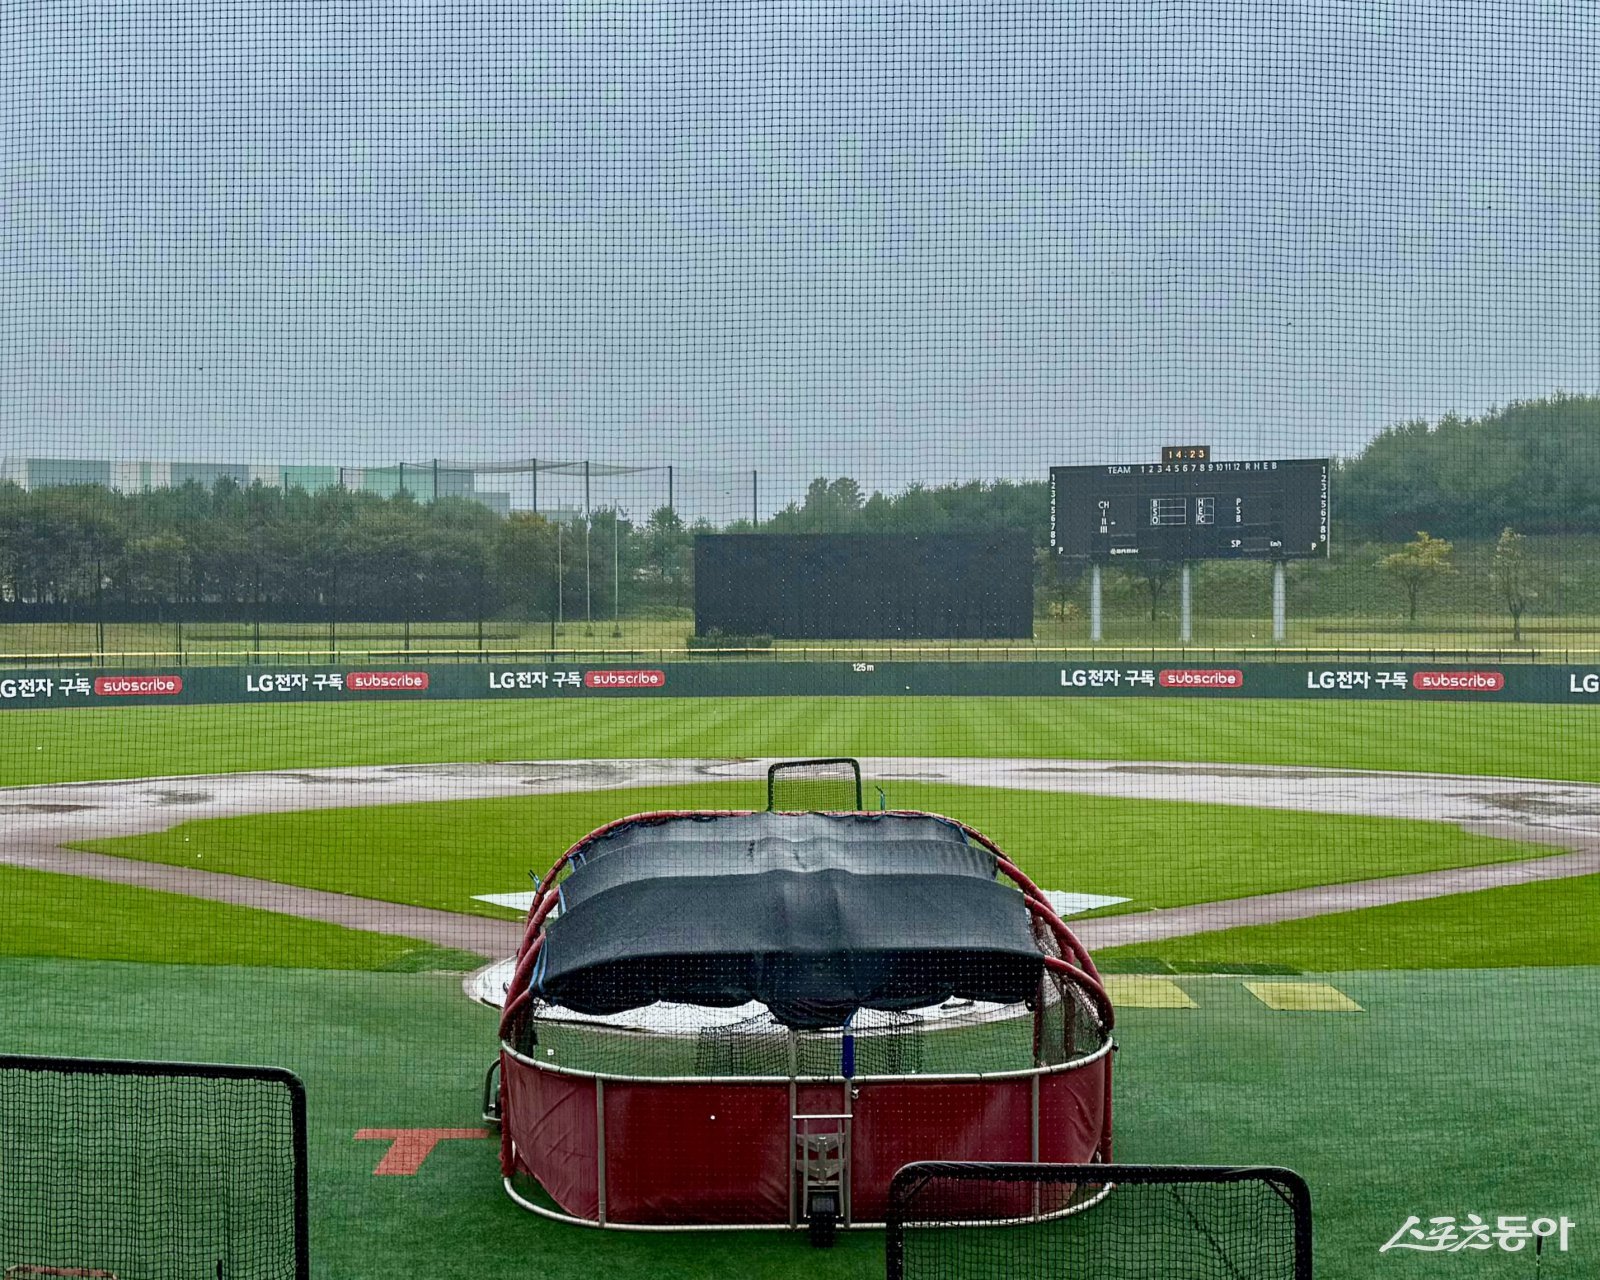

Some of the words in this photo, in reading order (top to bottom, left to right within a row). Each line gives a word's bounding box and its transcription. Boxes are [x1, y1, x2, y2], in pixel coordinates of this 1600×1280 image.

[1169, 450, 1204, 459] 14:23
[1108, 466, 1131, 474] TEAM
[1149, 465, 1154, 473] 2
[1157, 465, 1162, 473] 3
[1182, 464, 1188, 472] 6
[1191, 464, 1196, 472] 7
[1199, 464, 1205, 472] 8
[1225, 463, 1231, 471] 11
[1263, 462, 1268, 470] E
[1271, 462, 1277, 470] B
[1322, 466, 1326, 474] 1
[1321, 483, 1326, 491] 3
[1050, 490, 1056, 498] 3
[1050, 498, 1056, 506] 4
[1098, 501, 1109, 509] CH
[1320, 500, 1326, 508] 5
[1152, 508, 1158, 516] S
[1198, 507, 1203, 515] E
[1236, 506, 1241, 514] S
[1152, 516, 1158, 524] O
[1320, 525, 1326, 533] 8
[1320, 534, 1326, 542] 9
[1050, 539, 1056, 547] 9
[1231, 540, 1241, 548] SP
[1312, 543, 1317, 551] P
[246, 674, 309, 692] LG전자
[312, 673, 344, 691] 구독
[355, 672, 423, 687] subscribe
[489, 671, 549, 689] LG전자
[552, 671, 582, 688] 구독
[593, 671, 659, 685] subscribe
[1060, 669, 1121, 687] LG전자
[1124, 670, 1156, 687] 구독
[1167, 671, 1236, 685] subscribe
[1307, 671, 1371, 689] LG전자
[1375, 671, 1409, 689] 구독
[1422, 673, 1497, 688] subscribe
[0, 678, 54, 698] G전자
[58, 677, 91, 697] 구독
[103, 677, 175, 693] subscribe
